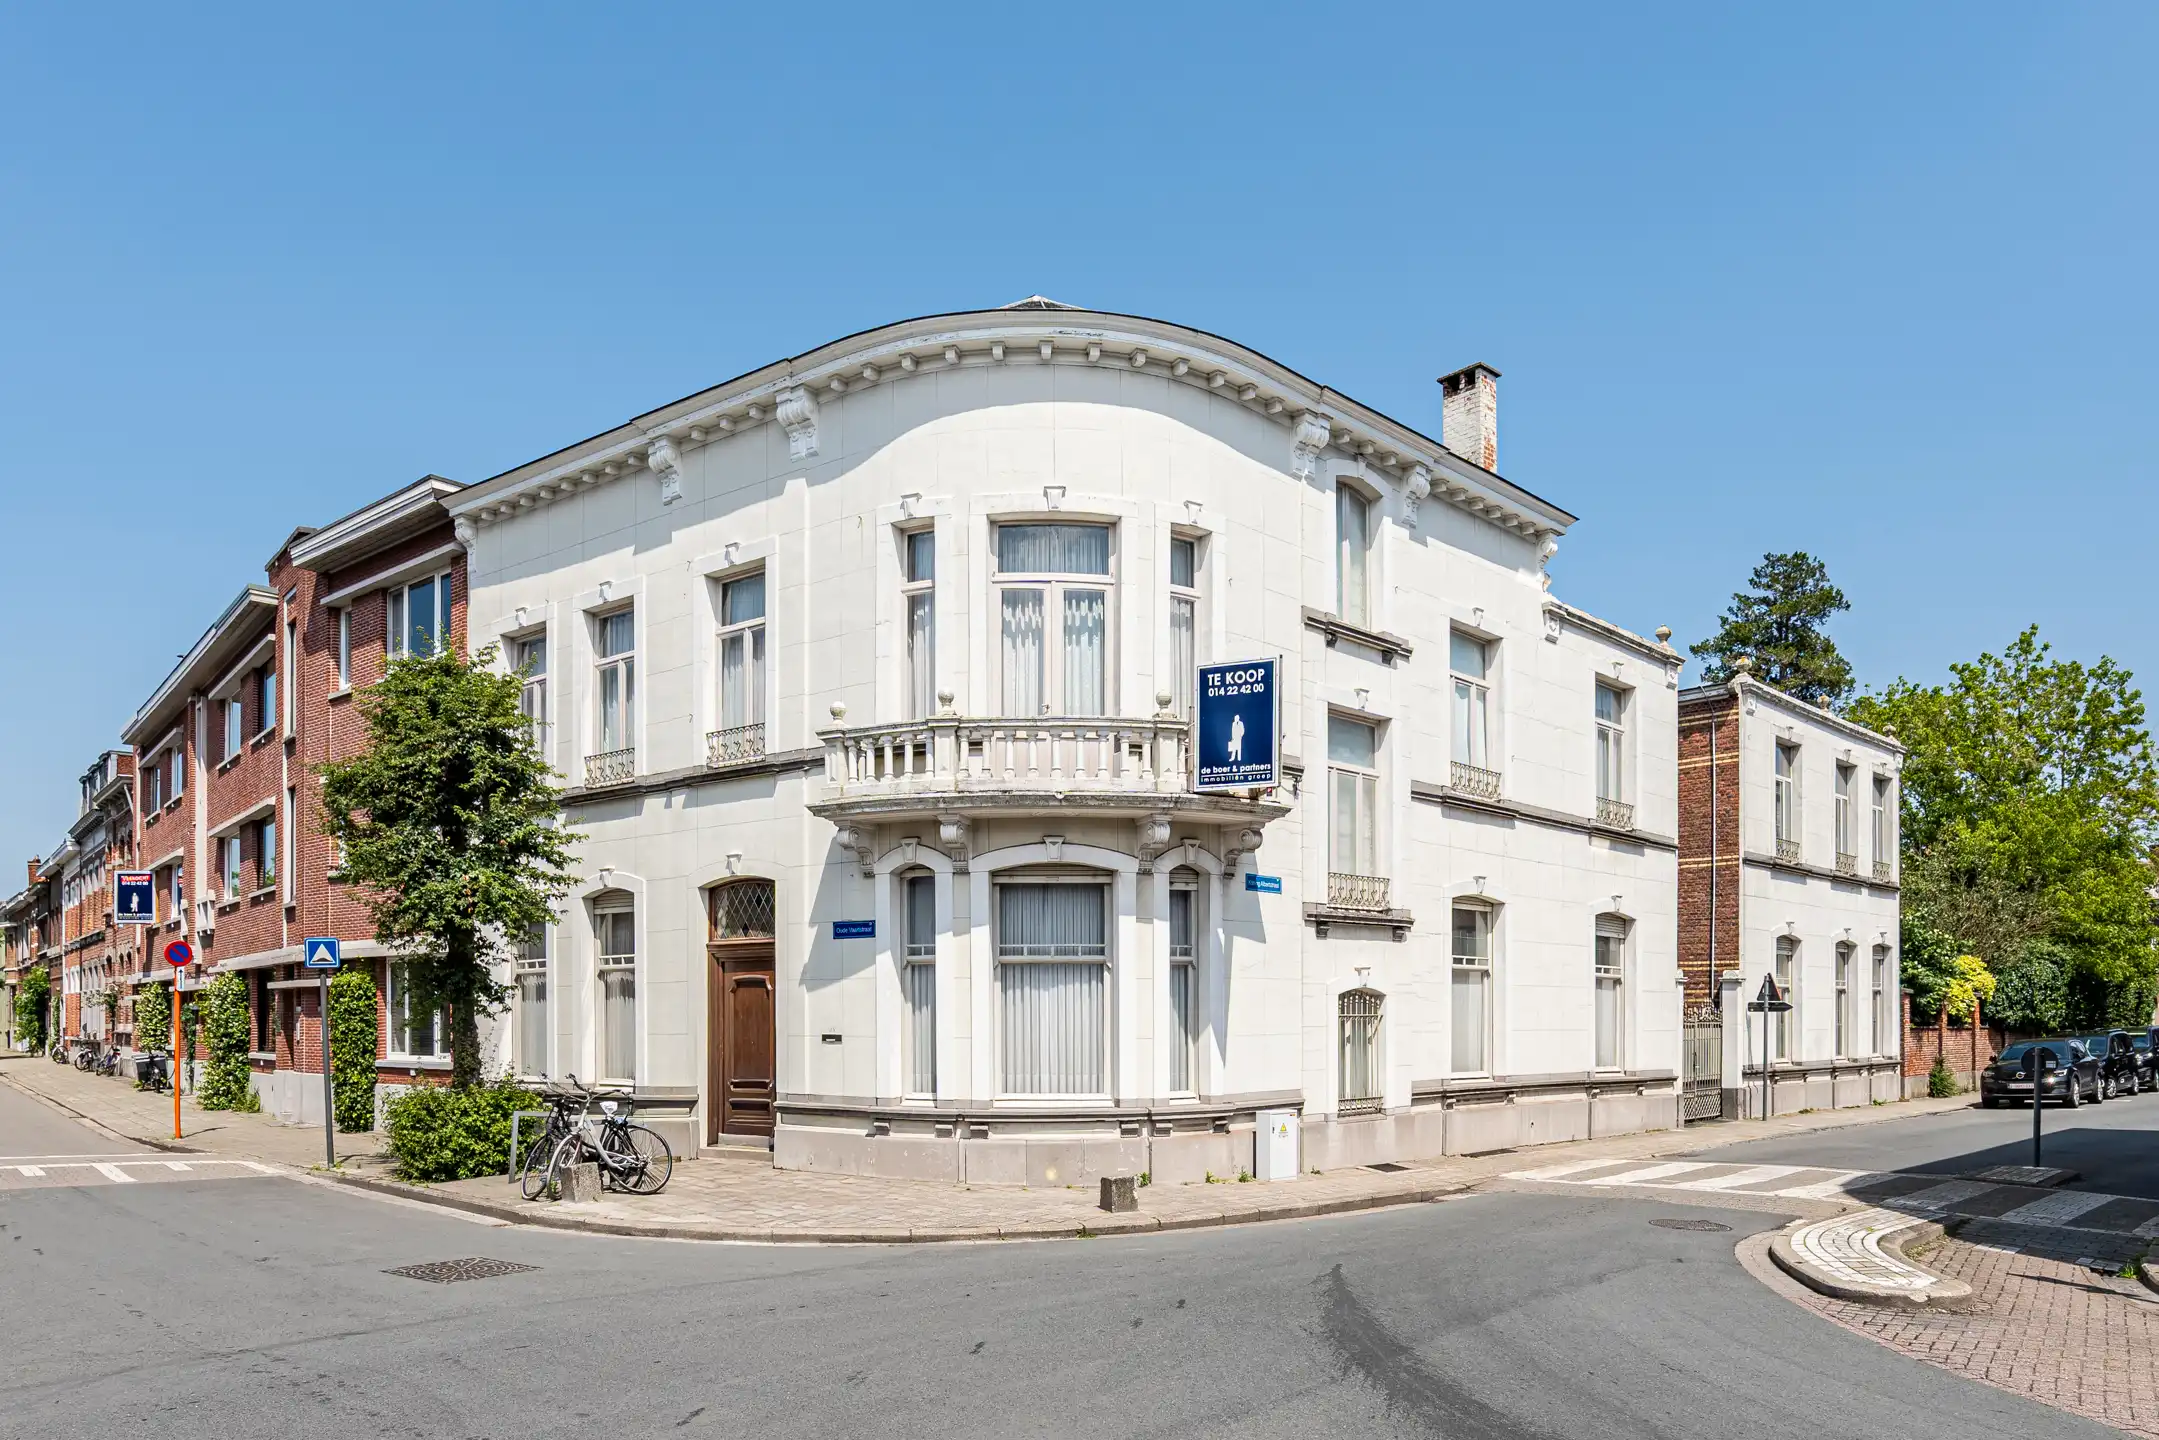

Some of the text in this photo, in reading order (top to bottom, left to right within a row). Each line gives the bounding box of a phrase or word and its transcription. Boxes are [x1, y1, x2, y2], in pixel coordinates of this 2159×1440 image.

[1208, 668, 1265, 686] TE KOOP
[1208, 683, 1265, 697] 014 22 42 00
[1212, 766, 1231, 774] boer
[1239, 763, 1271, 773] partners
